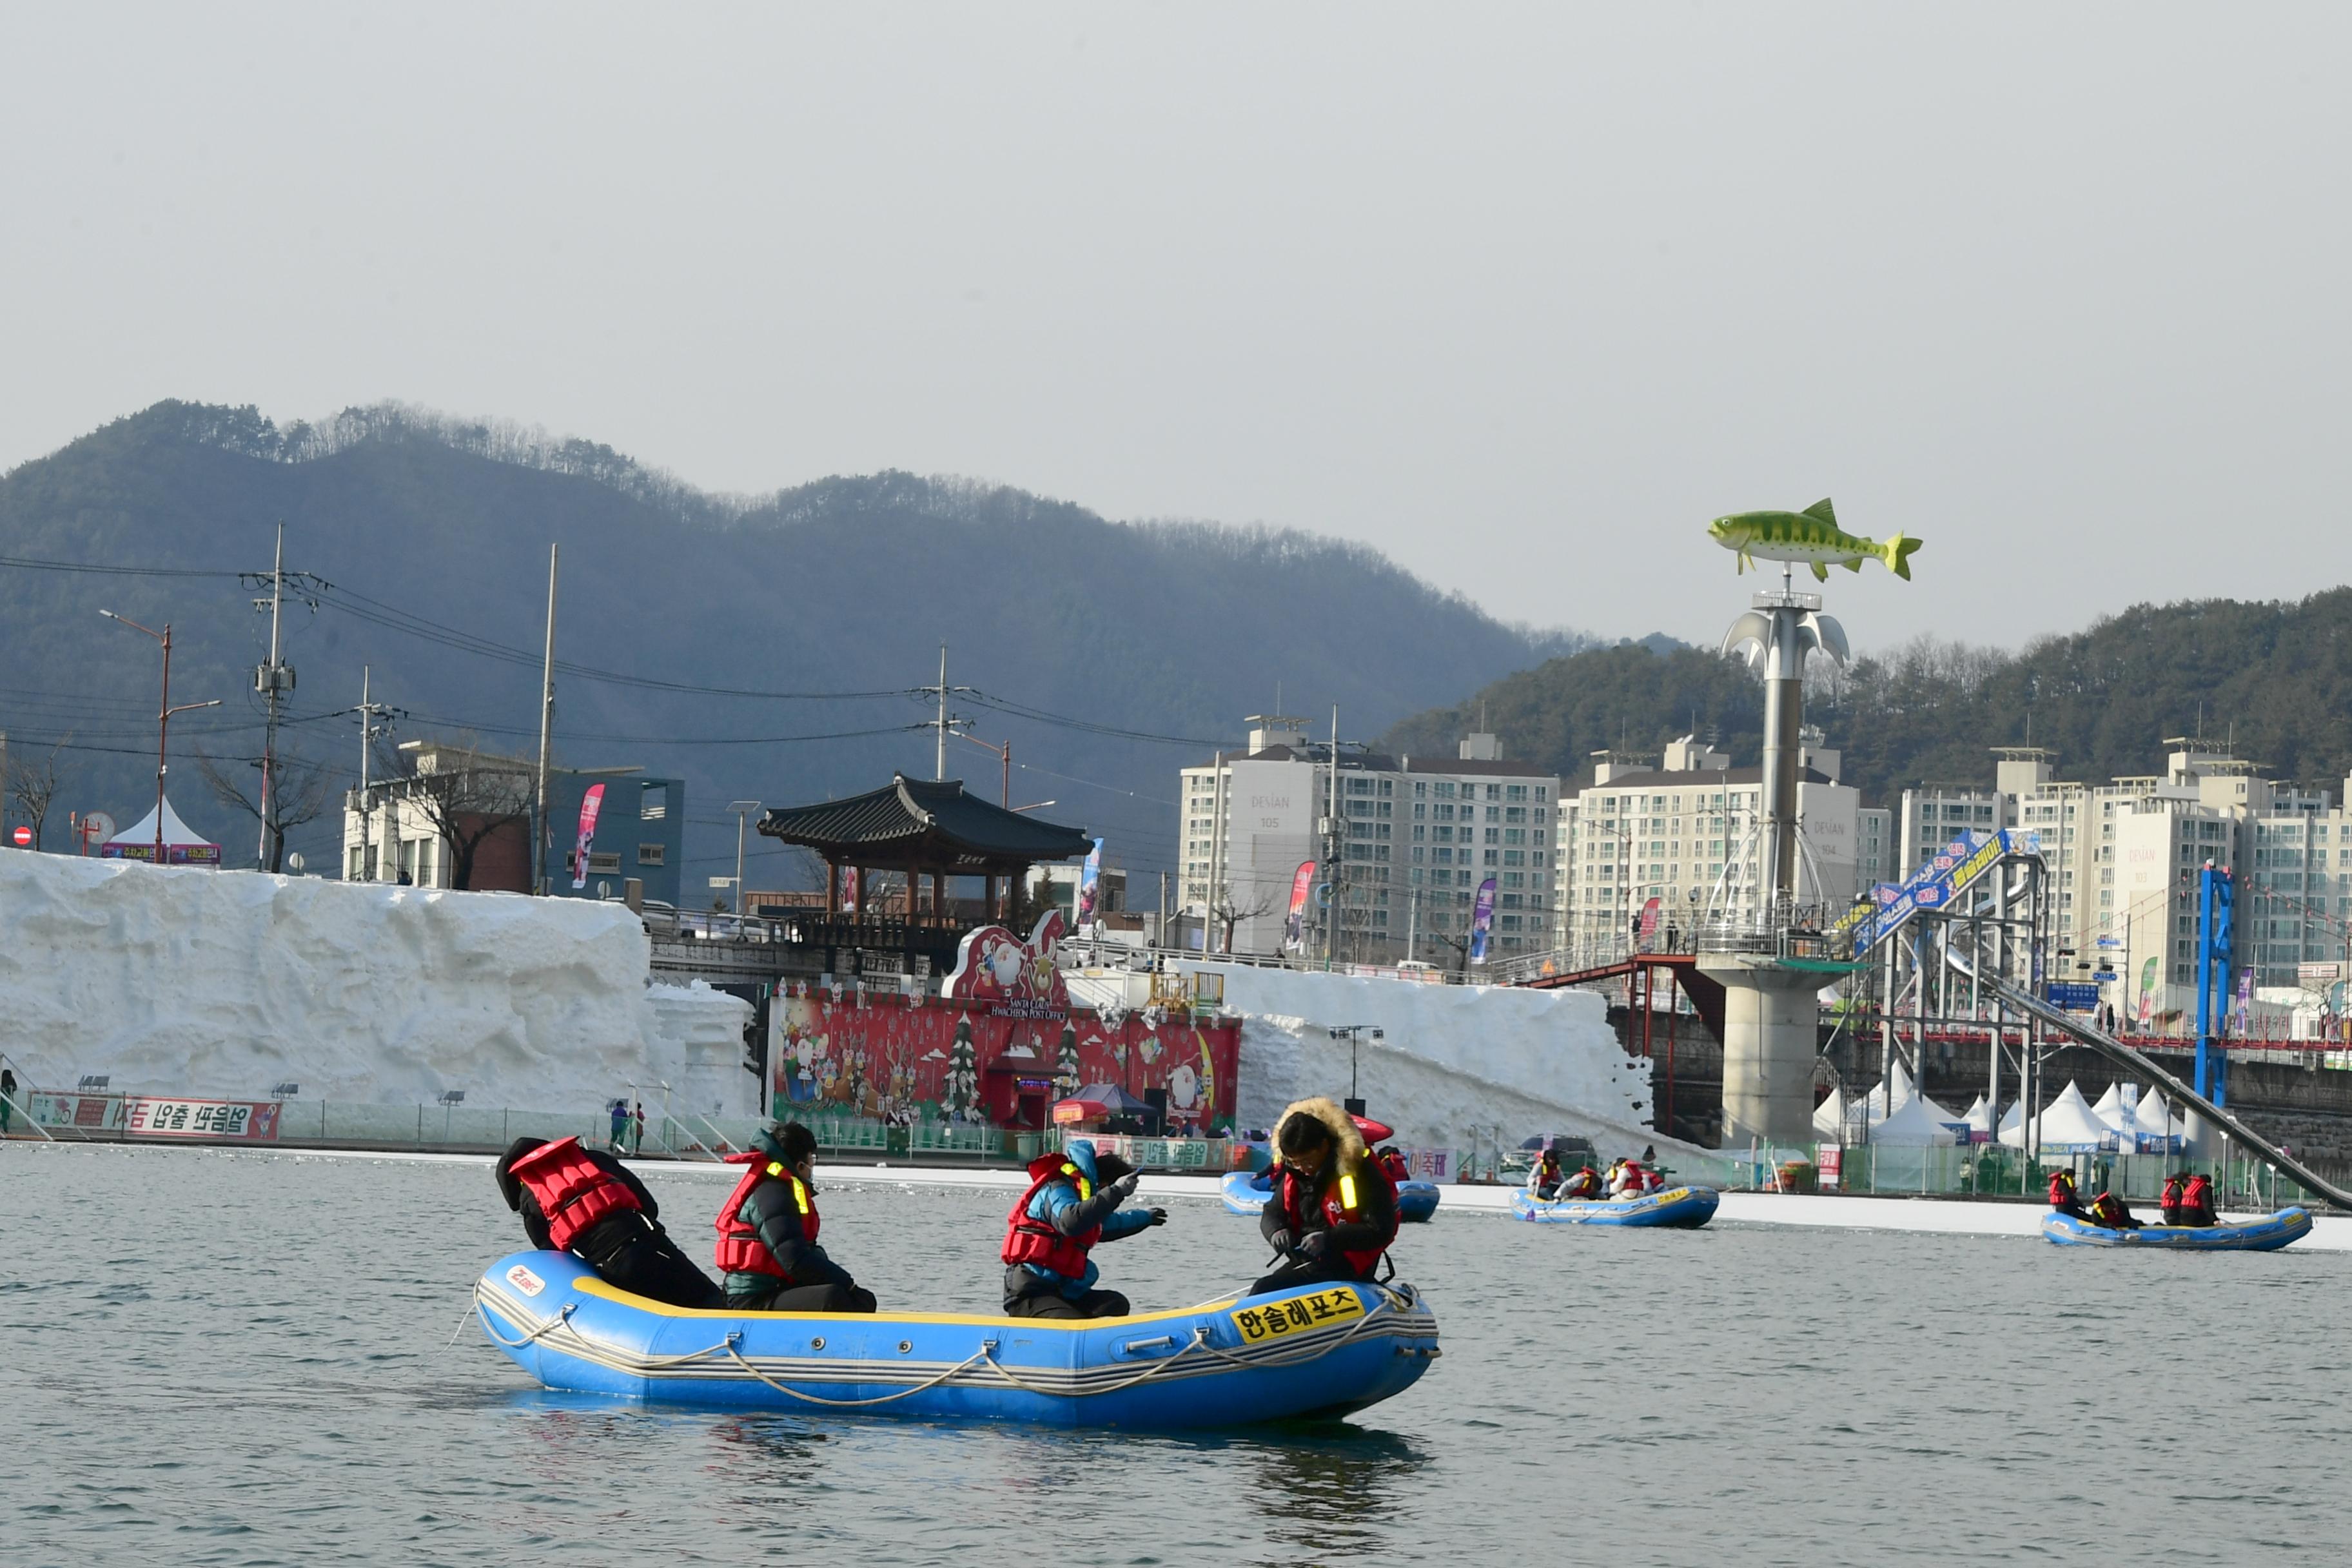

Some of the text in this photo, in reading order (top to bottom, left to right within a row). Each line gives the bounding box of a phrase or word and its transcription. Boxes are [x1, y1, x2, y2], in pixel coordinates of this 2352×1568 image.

[1251, 792, 1290, 808] DESIAN
[1261, 817, 1280, 828] 105
[1010, 997, 1050, 1010] SANTA CLAUS
[992, 1006, 1066, 1021] HWACHEON POST OFFICE
[1237, 1290, 1358, 1338] 한솔레포츠
